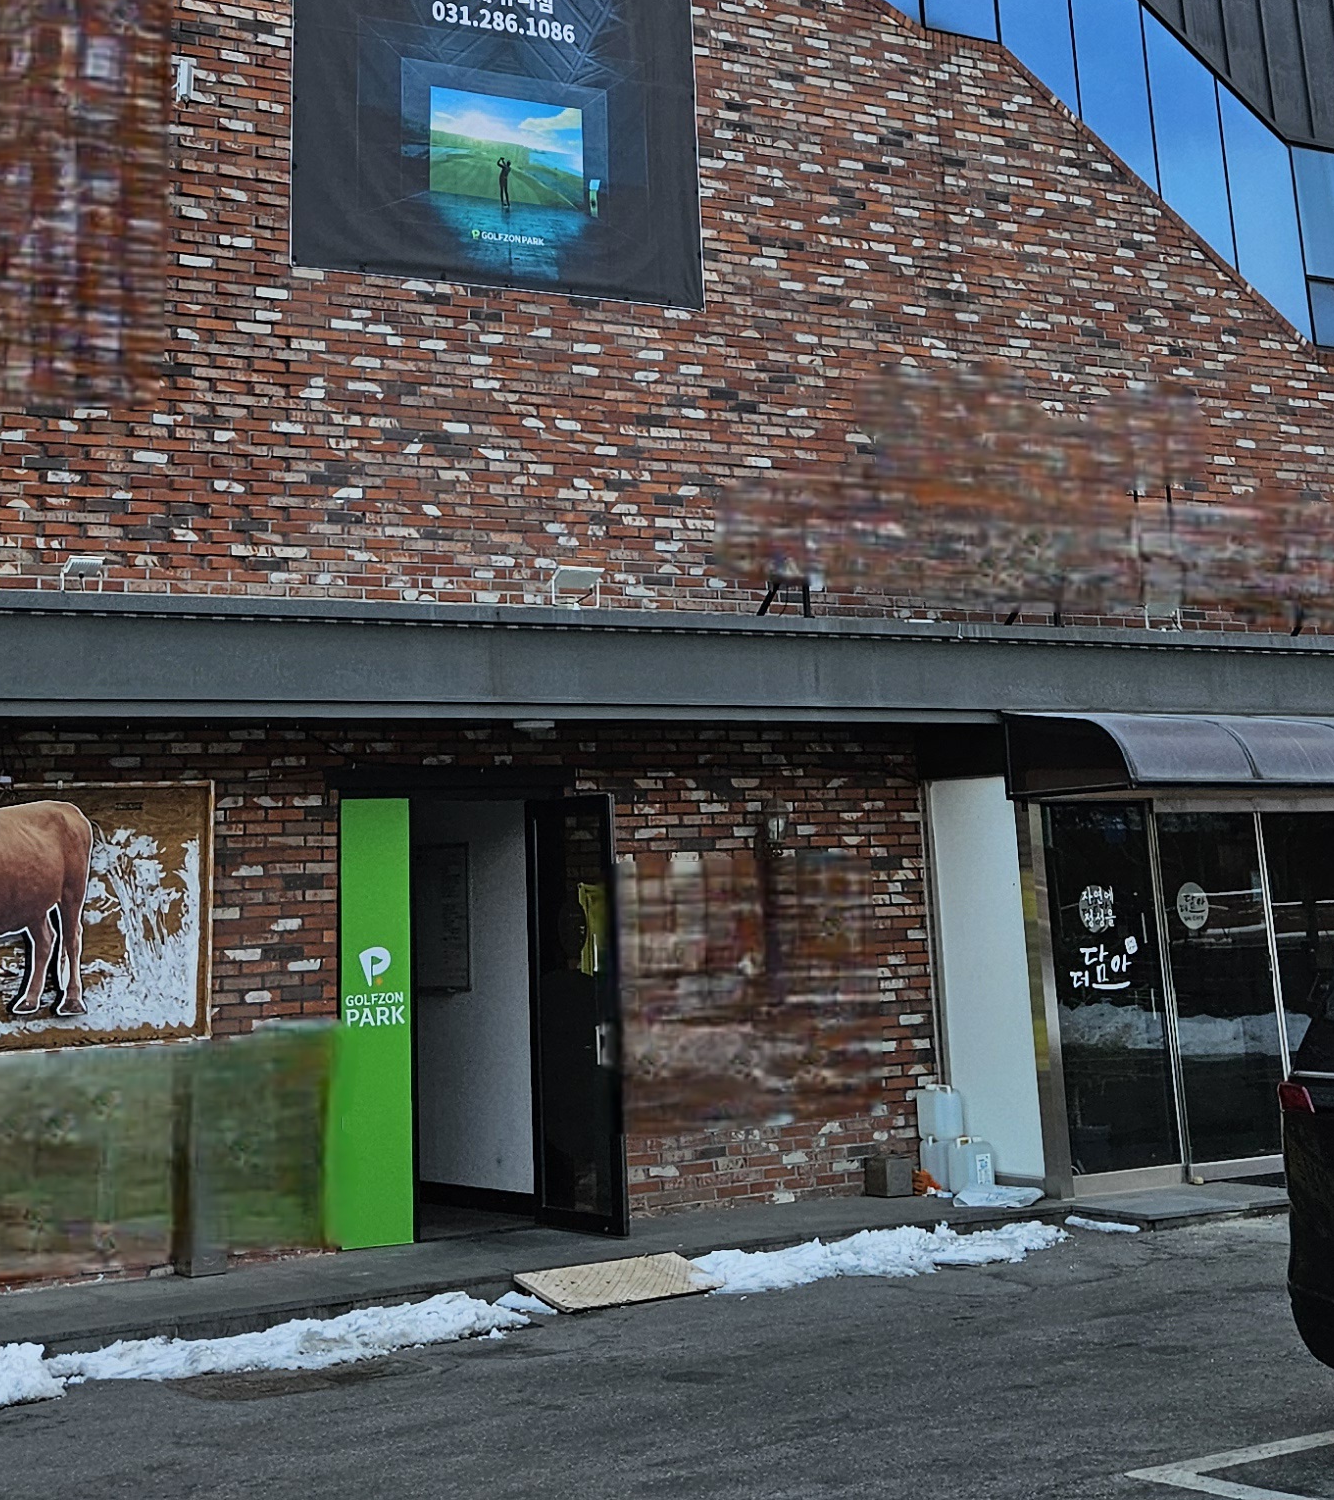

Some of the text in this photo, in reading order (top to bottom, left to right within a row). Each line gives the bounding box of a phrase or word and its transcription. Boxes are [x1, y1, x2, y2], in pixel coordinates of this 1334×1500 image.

[432, 0, 576, 44] 031.286.1086
[1081, 885, 1114, 905] 자연에
[1084, 908, 1117, 928] 정성을
[345, 991, 404, 1007] GOLFZON
[345, 1005, 406, 1028] PARK
